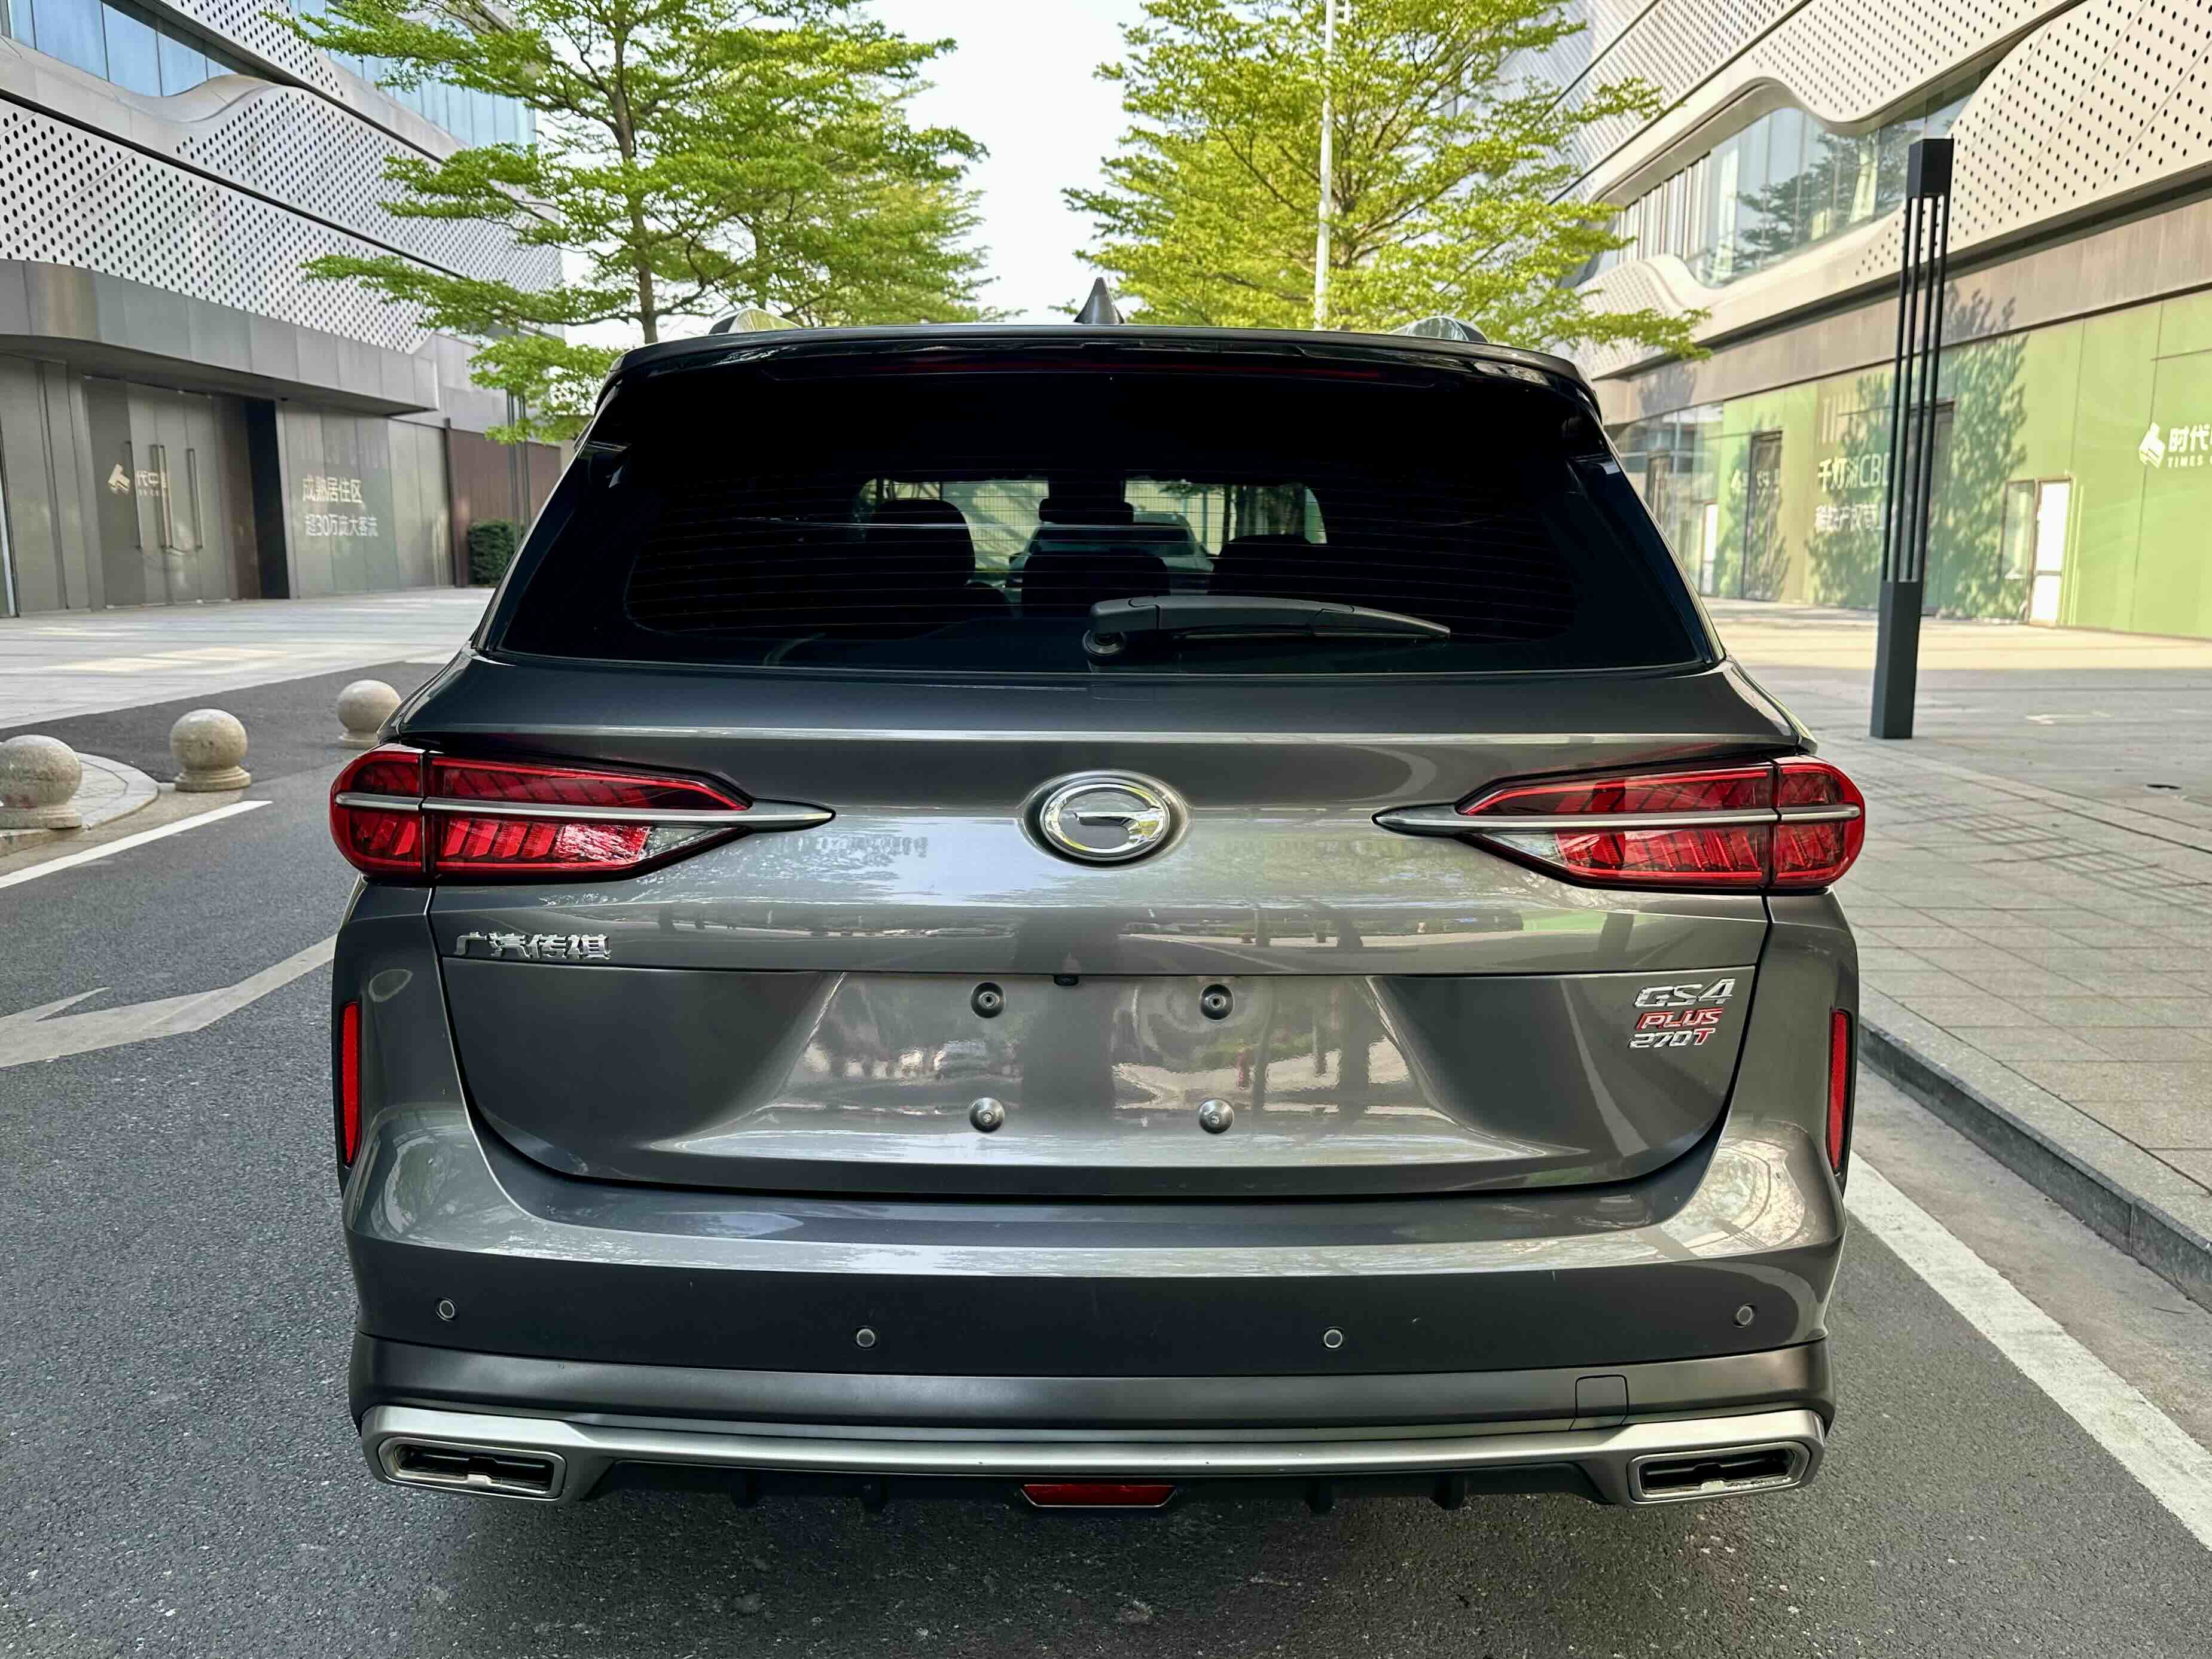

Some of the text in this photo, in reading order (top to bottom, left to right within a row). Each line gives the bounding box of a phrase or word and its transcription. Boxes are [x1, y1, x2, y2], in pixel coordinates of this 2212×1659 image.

[2168, 423, 2212, 453] 时代
[2168, 455, 2203, 469] TIMES
[454, 931, 611, 959] 广汽传祺
[1634, 978, 1735, 1007] GS4
[1636, 1007, 1723, 1030] PLUS
[1628, 1027, 1716, 1048] 270T
